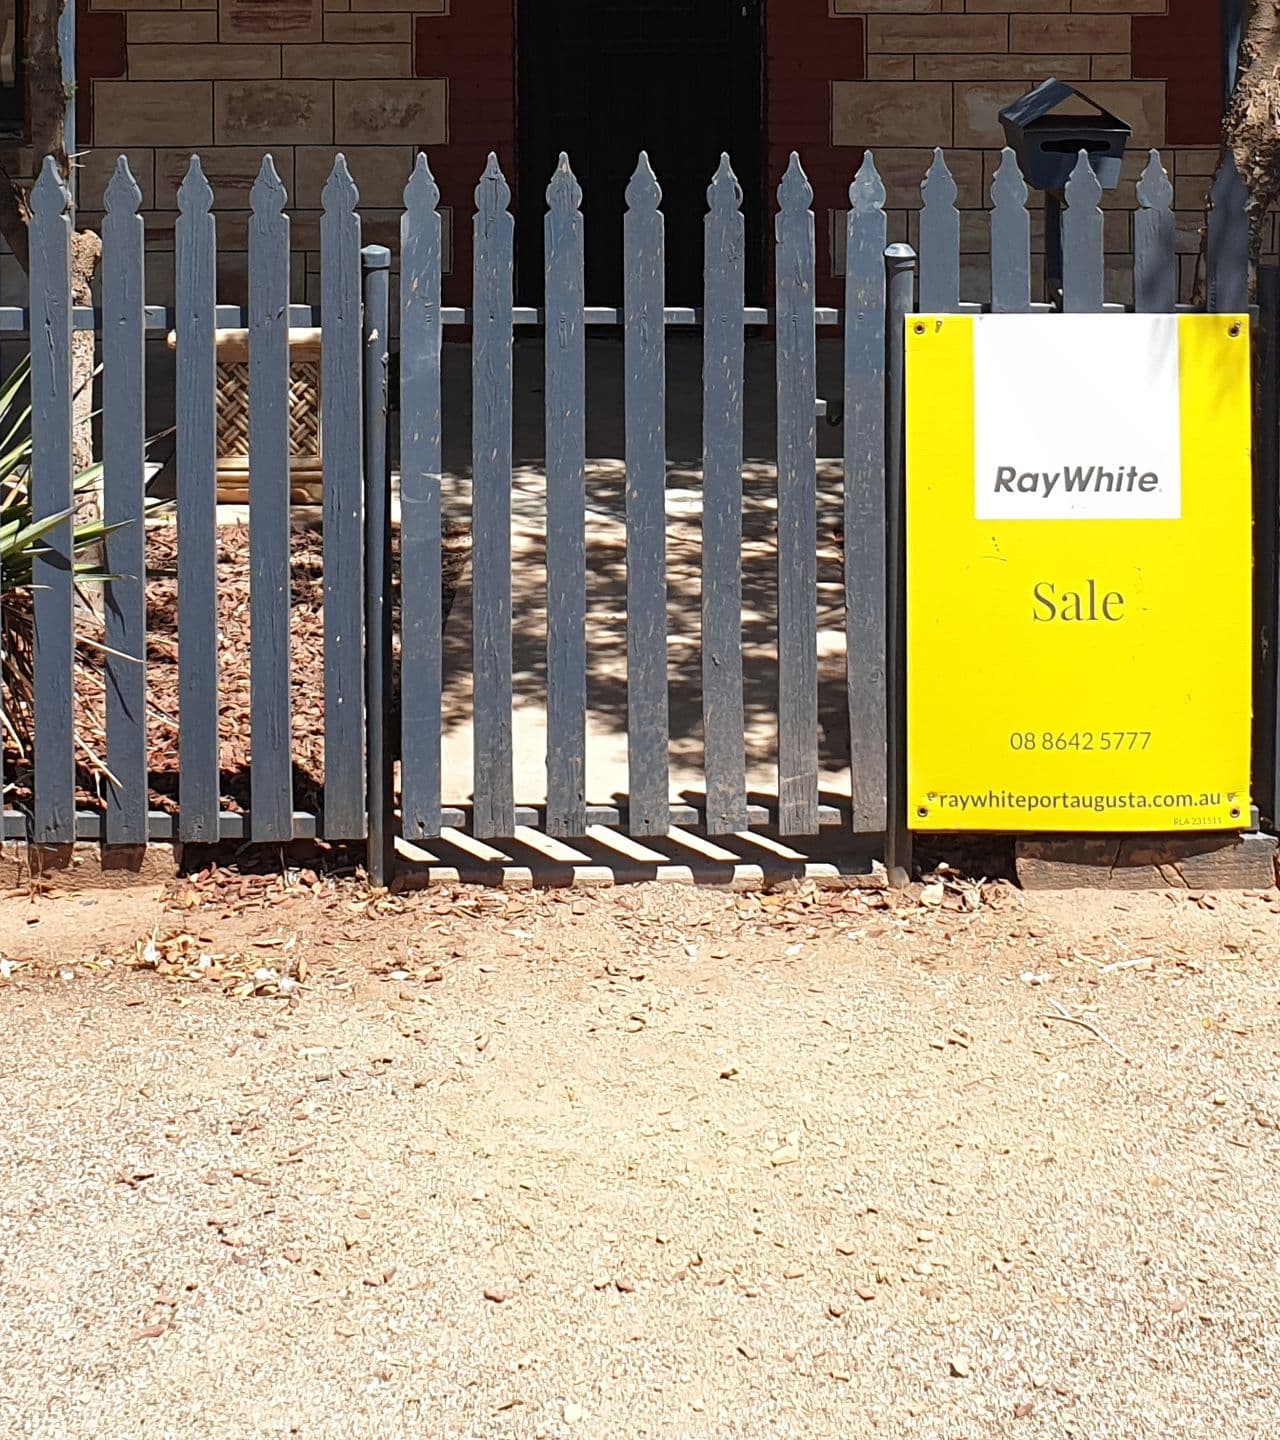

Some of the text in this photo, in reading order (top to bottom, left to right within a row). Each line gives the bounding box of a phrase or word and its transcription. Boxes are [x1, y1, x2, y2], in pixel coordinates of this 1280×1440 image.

[1032, 578, 1125, 622] Sale
[1009, 731, 1152, 751] 08 8642 5777
[939, 789, 1221, 812] raywhiteportaugusta.com.au
[1173, 817, 1190, 826] RLA
